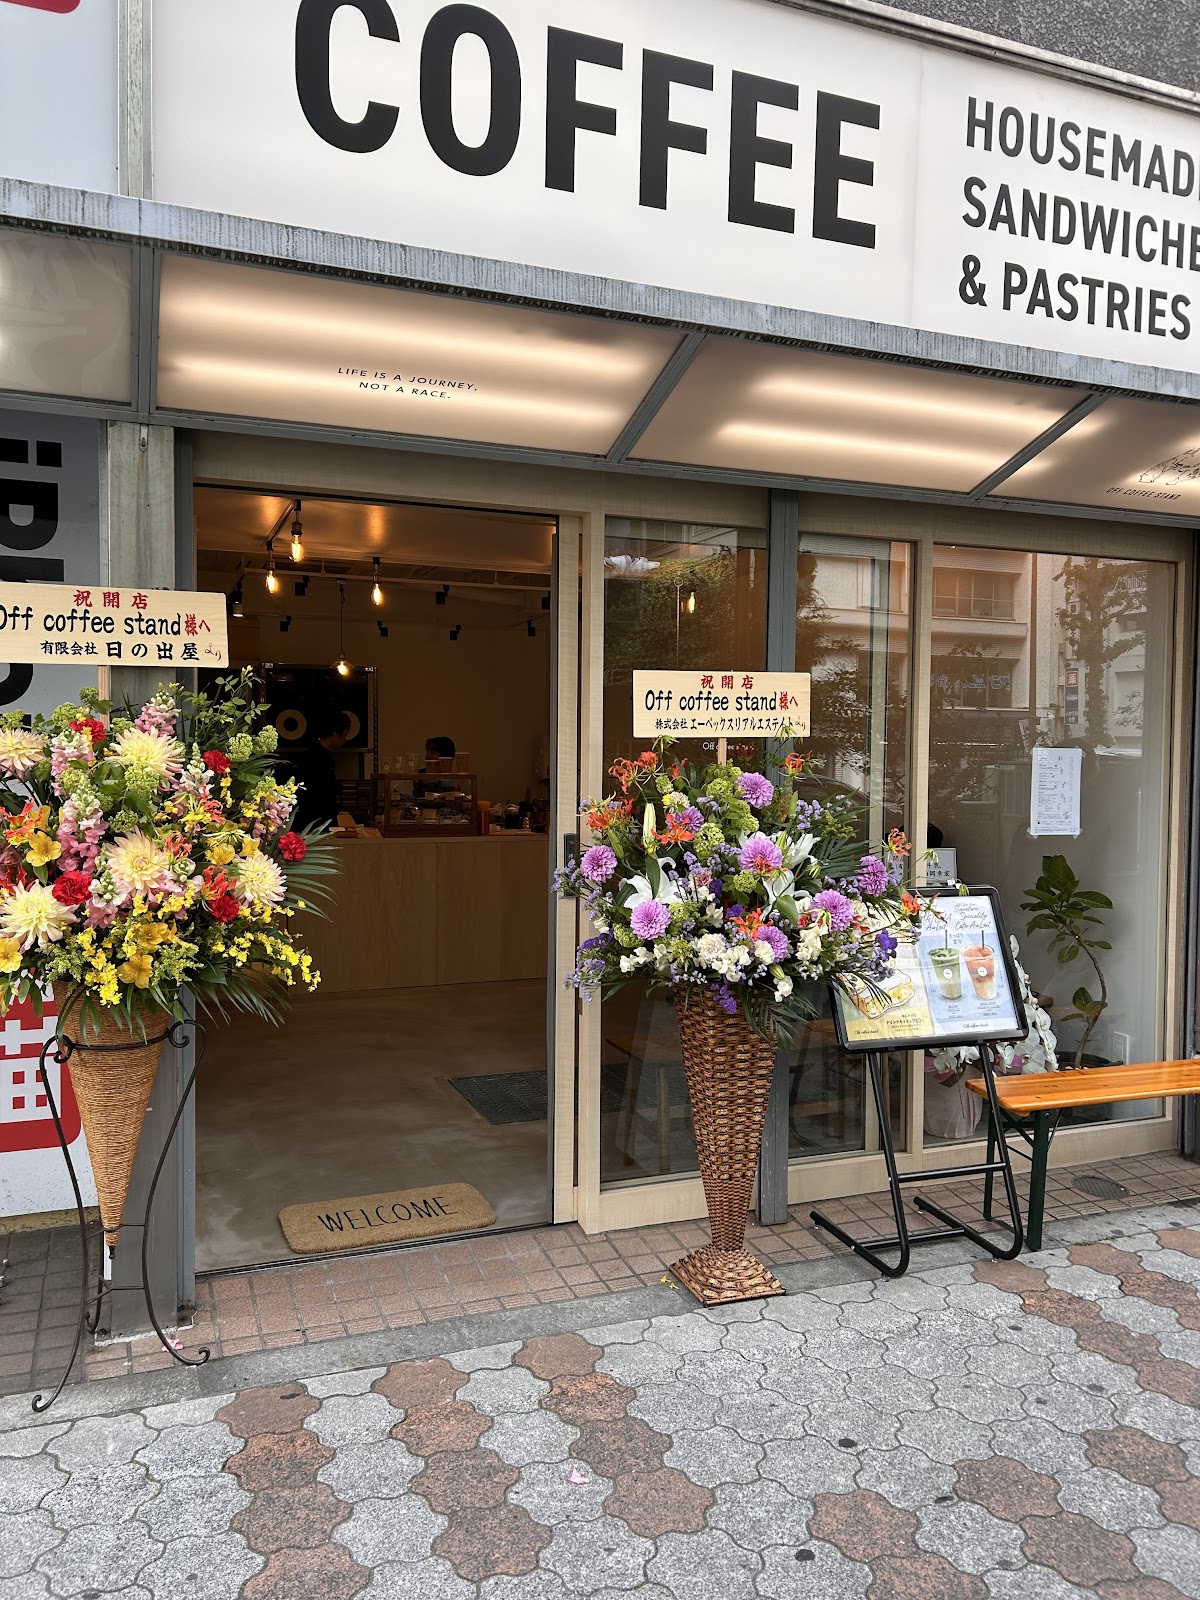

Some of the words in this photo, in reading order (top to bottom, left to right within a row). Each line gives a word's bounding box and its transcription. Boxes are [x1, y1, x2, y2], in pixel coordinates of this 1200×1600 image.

[295, 0, 880, 249] COFFEE
[966, 96, 1200, 200] HOUSEMAD
[958, 255, 987, 307] &
[1003, 261, 1191, 340] PASTRIES
[338, 367, 367, 377] LIFE
[374, 371, 386, 379] IS
[359, 381, 390, 391] NOT
[411, 388, 451, 399] RACE.
[1123, 488, 1155, 497] COFFEE
[1154, 492, 1181, 500] STAND
[43, 608, 115, 633] coffee
[40, 639, 98, 656] 有限会社
[645, 690, 673, 711] Off
[679, 690, 729, 711] coffee
[655, 718, 689, 730] 株式会社
[317, 1196, 458, 1232] WELCOME
